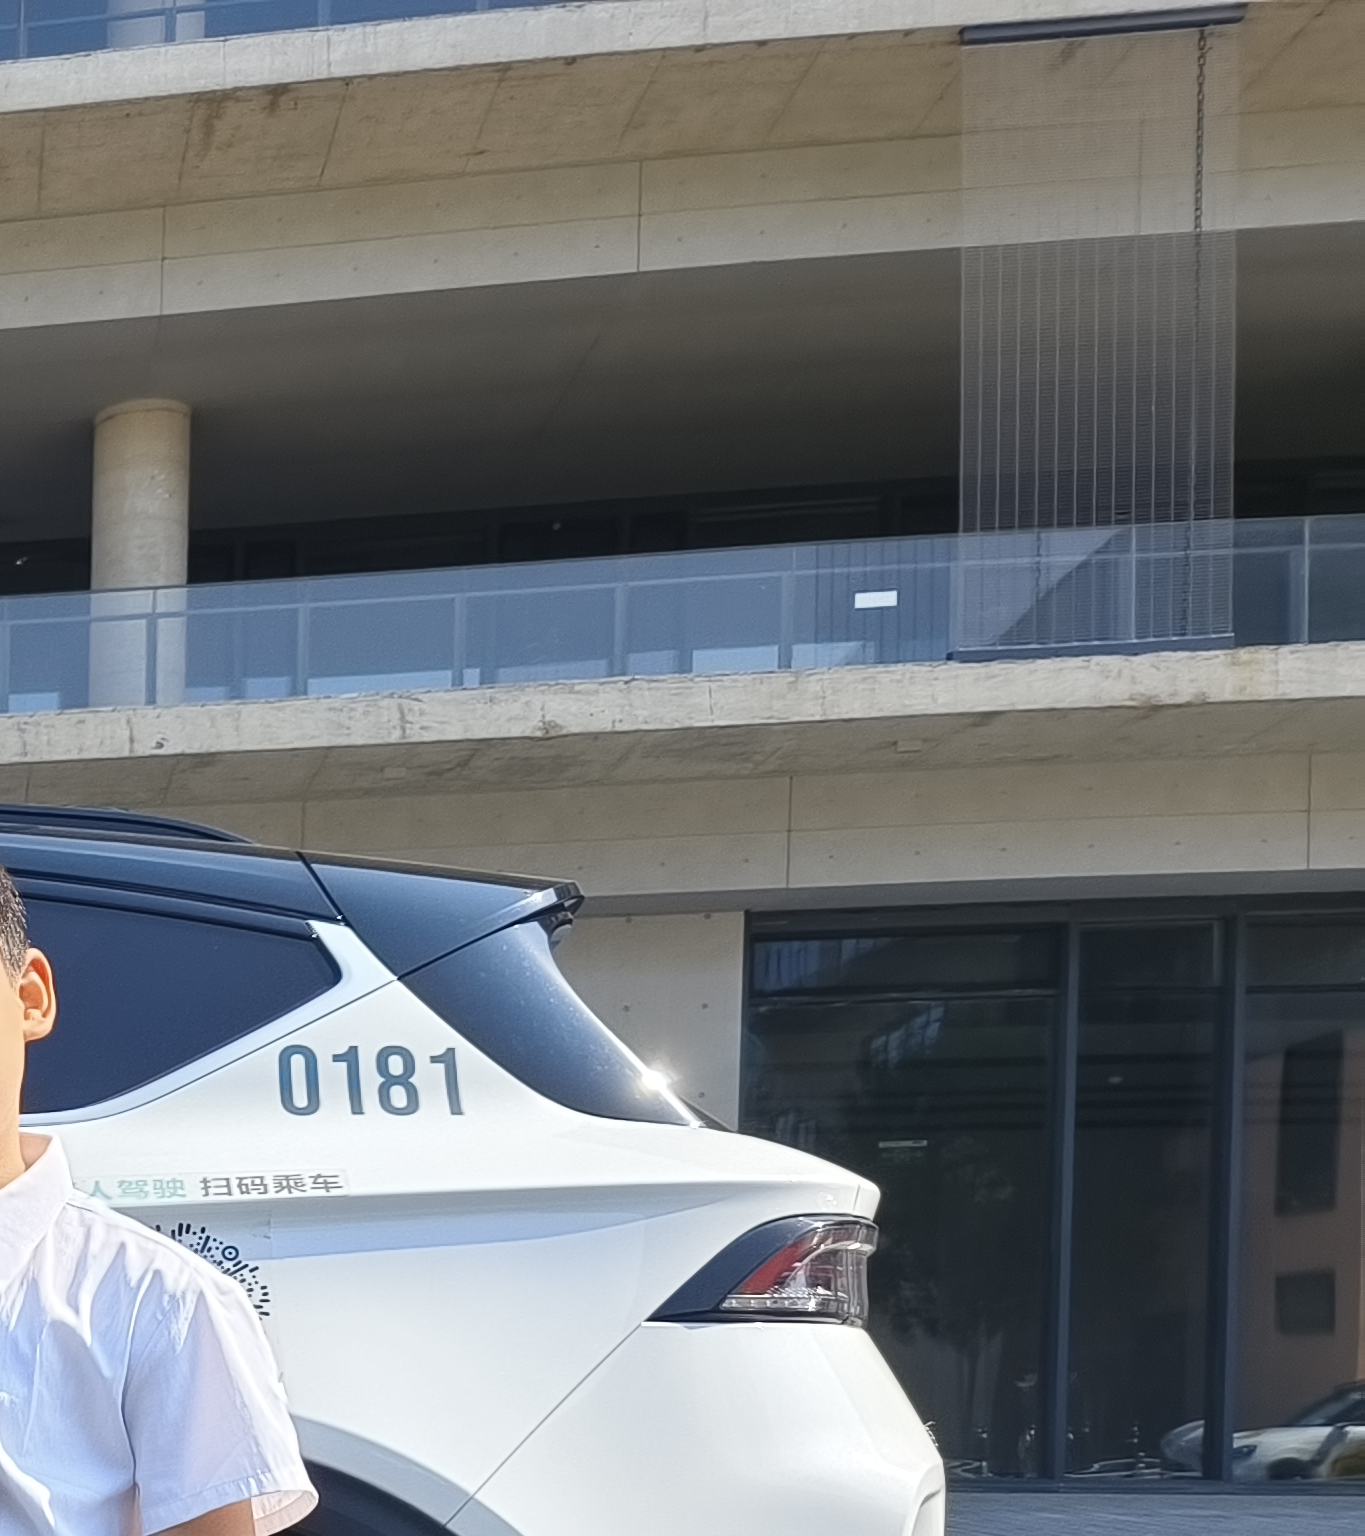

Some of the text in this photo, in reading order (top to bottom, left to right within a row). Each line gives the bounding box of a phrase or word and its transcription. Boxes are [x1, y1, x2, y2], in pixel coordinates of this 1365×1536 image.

[278, 1044, 466, 1117] 0181
[199, 1173, 344, 1198] 扫码乘车
